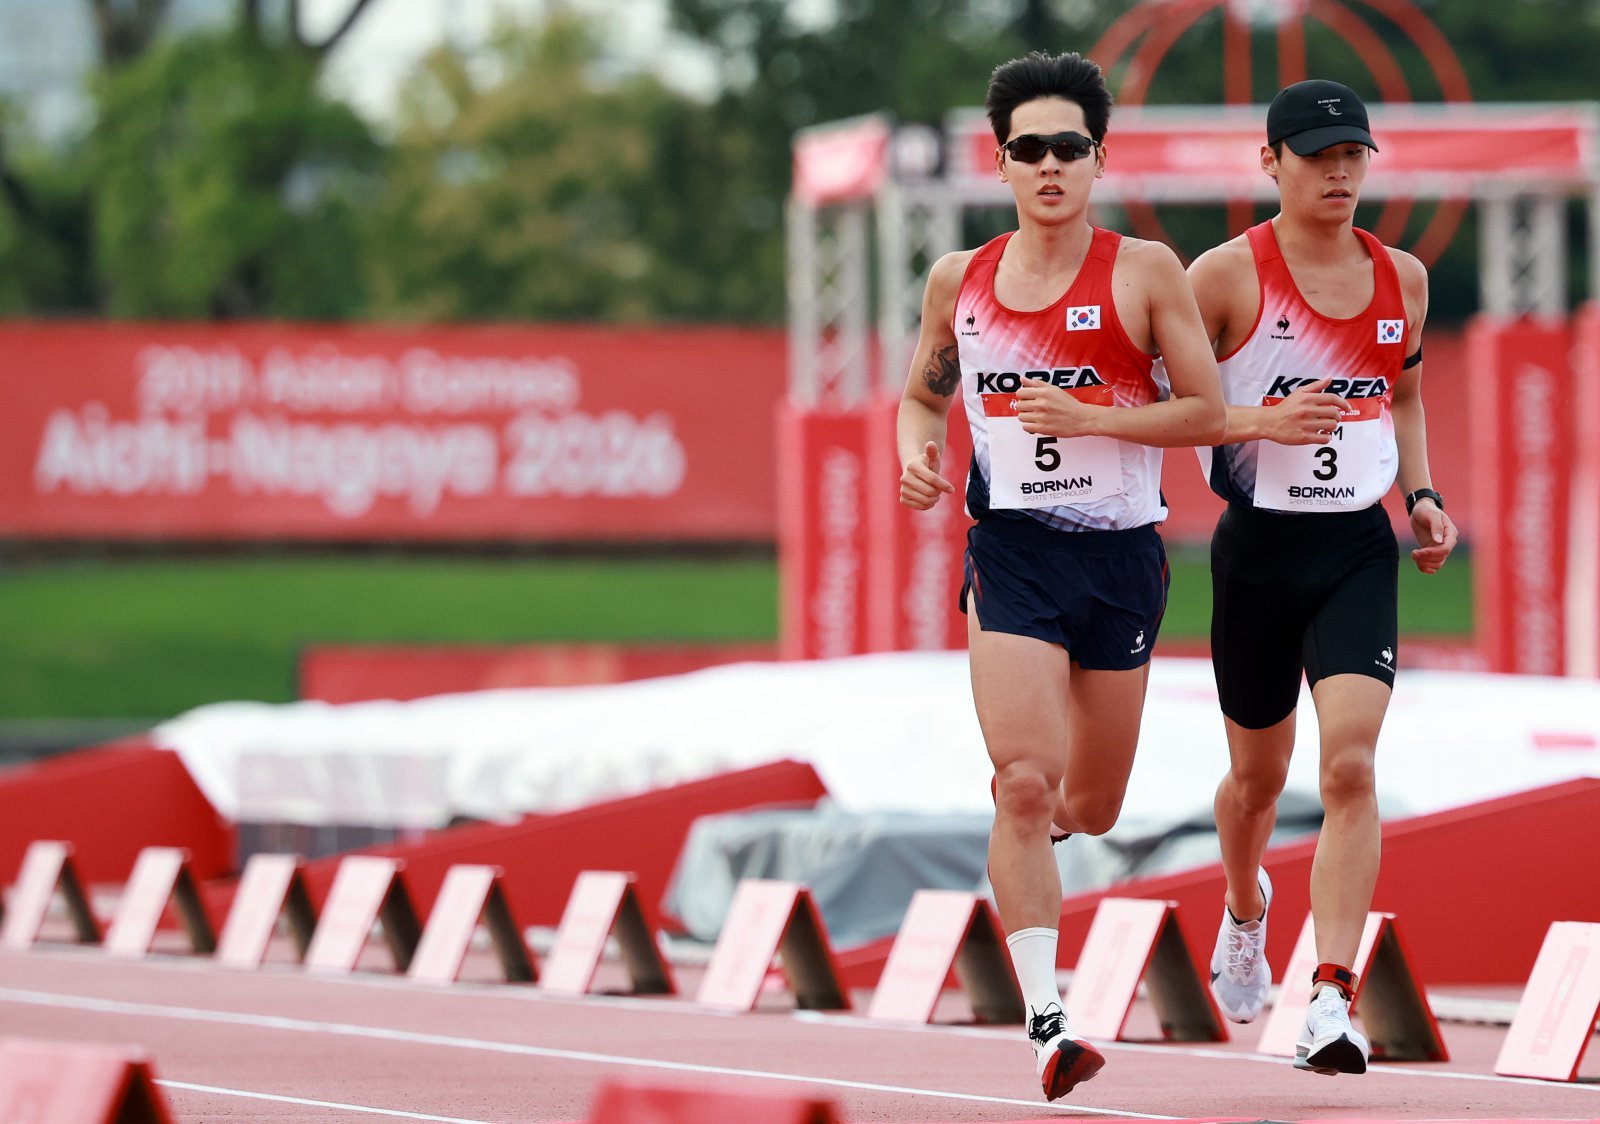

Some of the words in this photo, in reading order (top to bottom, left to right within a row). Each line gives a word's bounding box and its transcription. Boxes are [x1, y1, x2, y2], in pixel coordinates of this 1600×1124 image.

[505, 409, 688, 497] 2026
[1035, 437, 1061, 472] 5
[1313, 447, 1338, 481] 3
[1020, 475, 1093, 494] BORNAN
[1023, 493, 1047, 502] SPORTS
[1048, 488, 1093, 500] TECHNOLOGY
[1288, 486, 1355, 499] BORNAN
